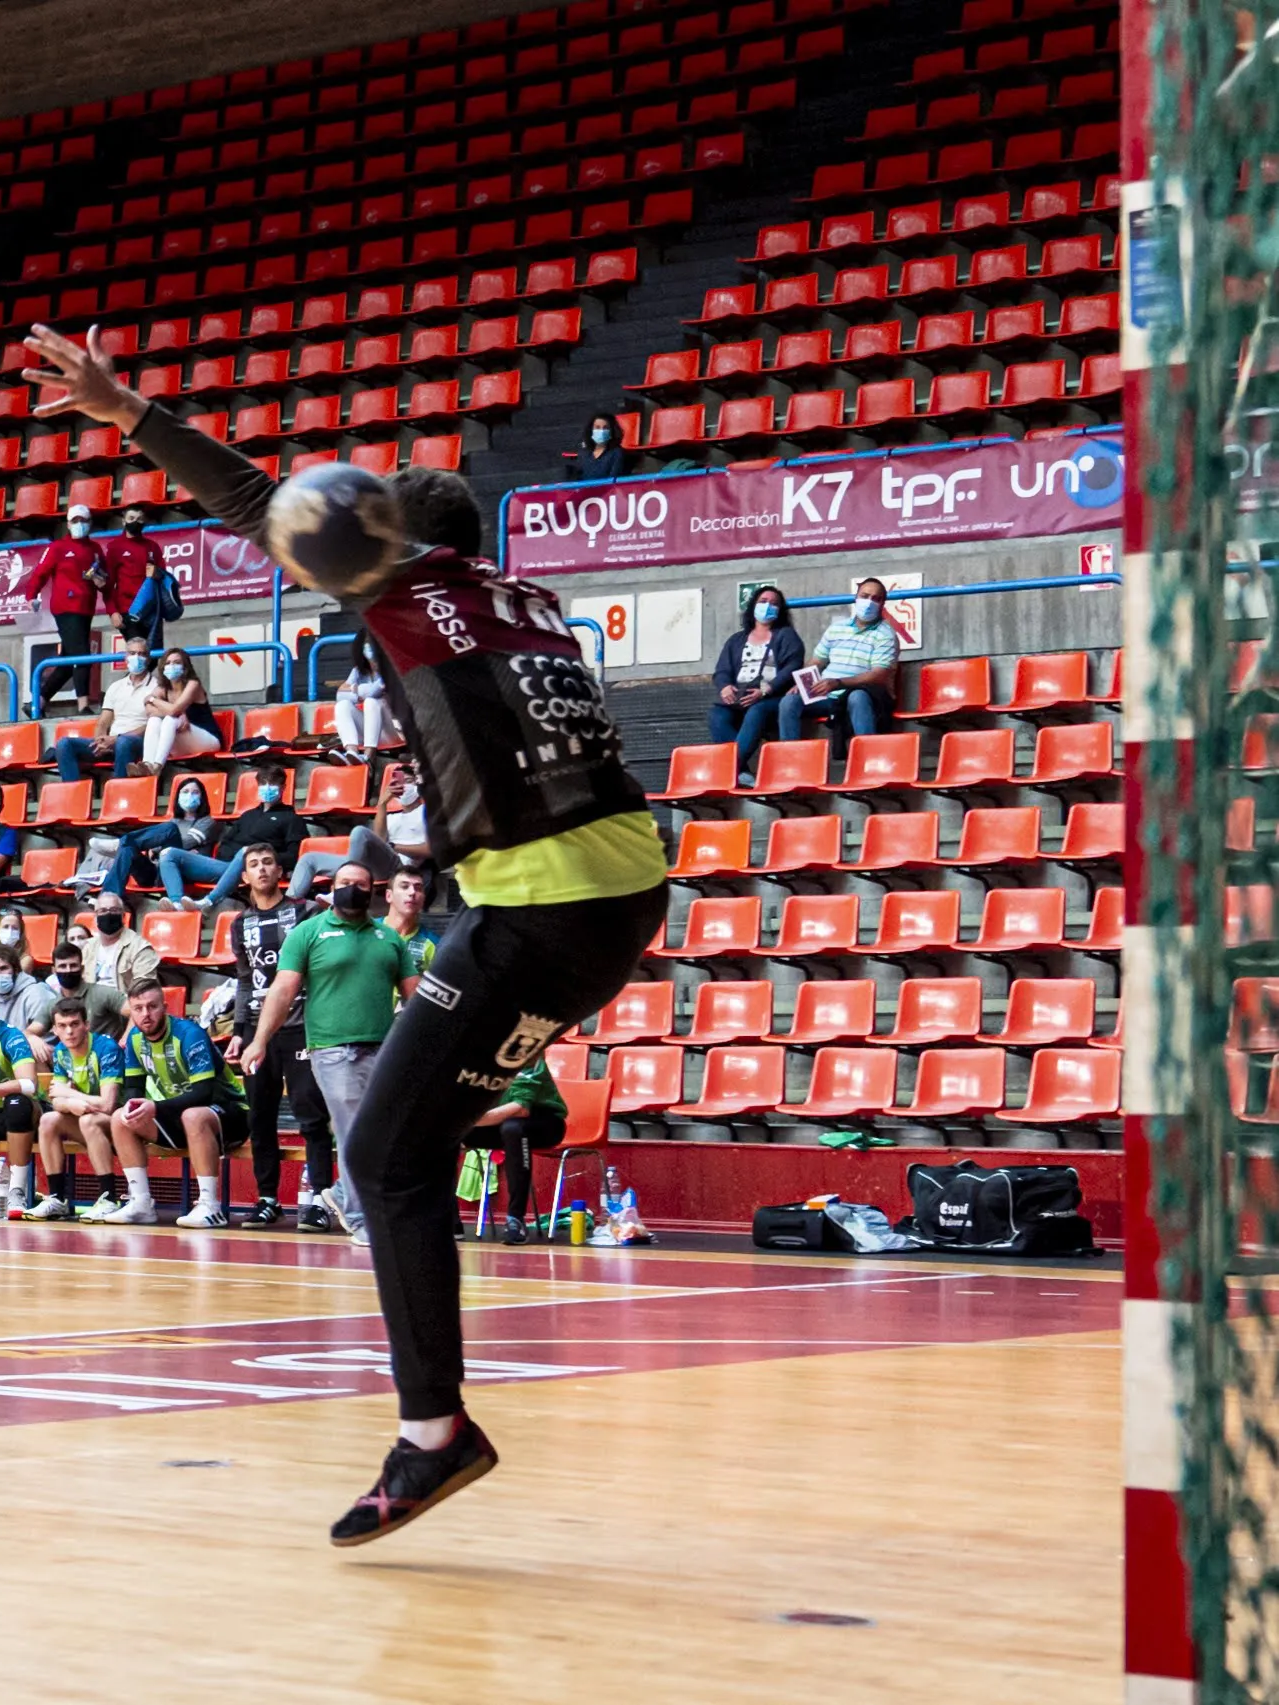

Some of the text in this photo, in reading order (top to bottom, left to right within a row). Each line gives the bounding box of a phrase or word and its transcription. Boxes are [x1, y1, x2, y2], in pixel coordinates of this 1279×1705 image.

[689, 471, 853, 534] Decoración K7
[607, 605, 627, 641] 8
